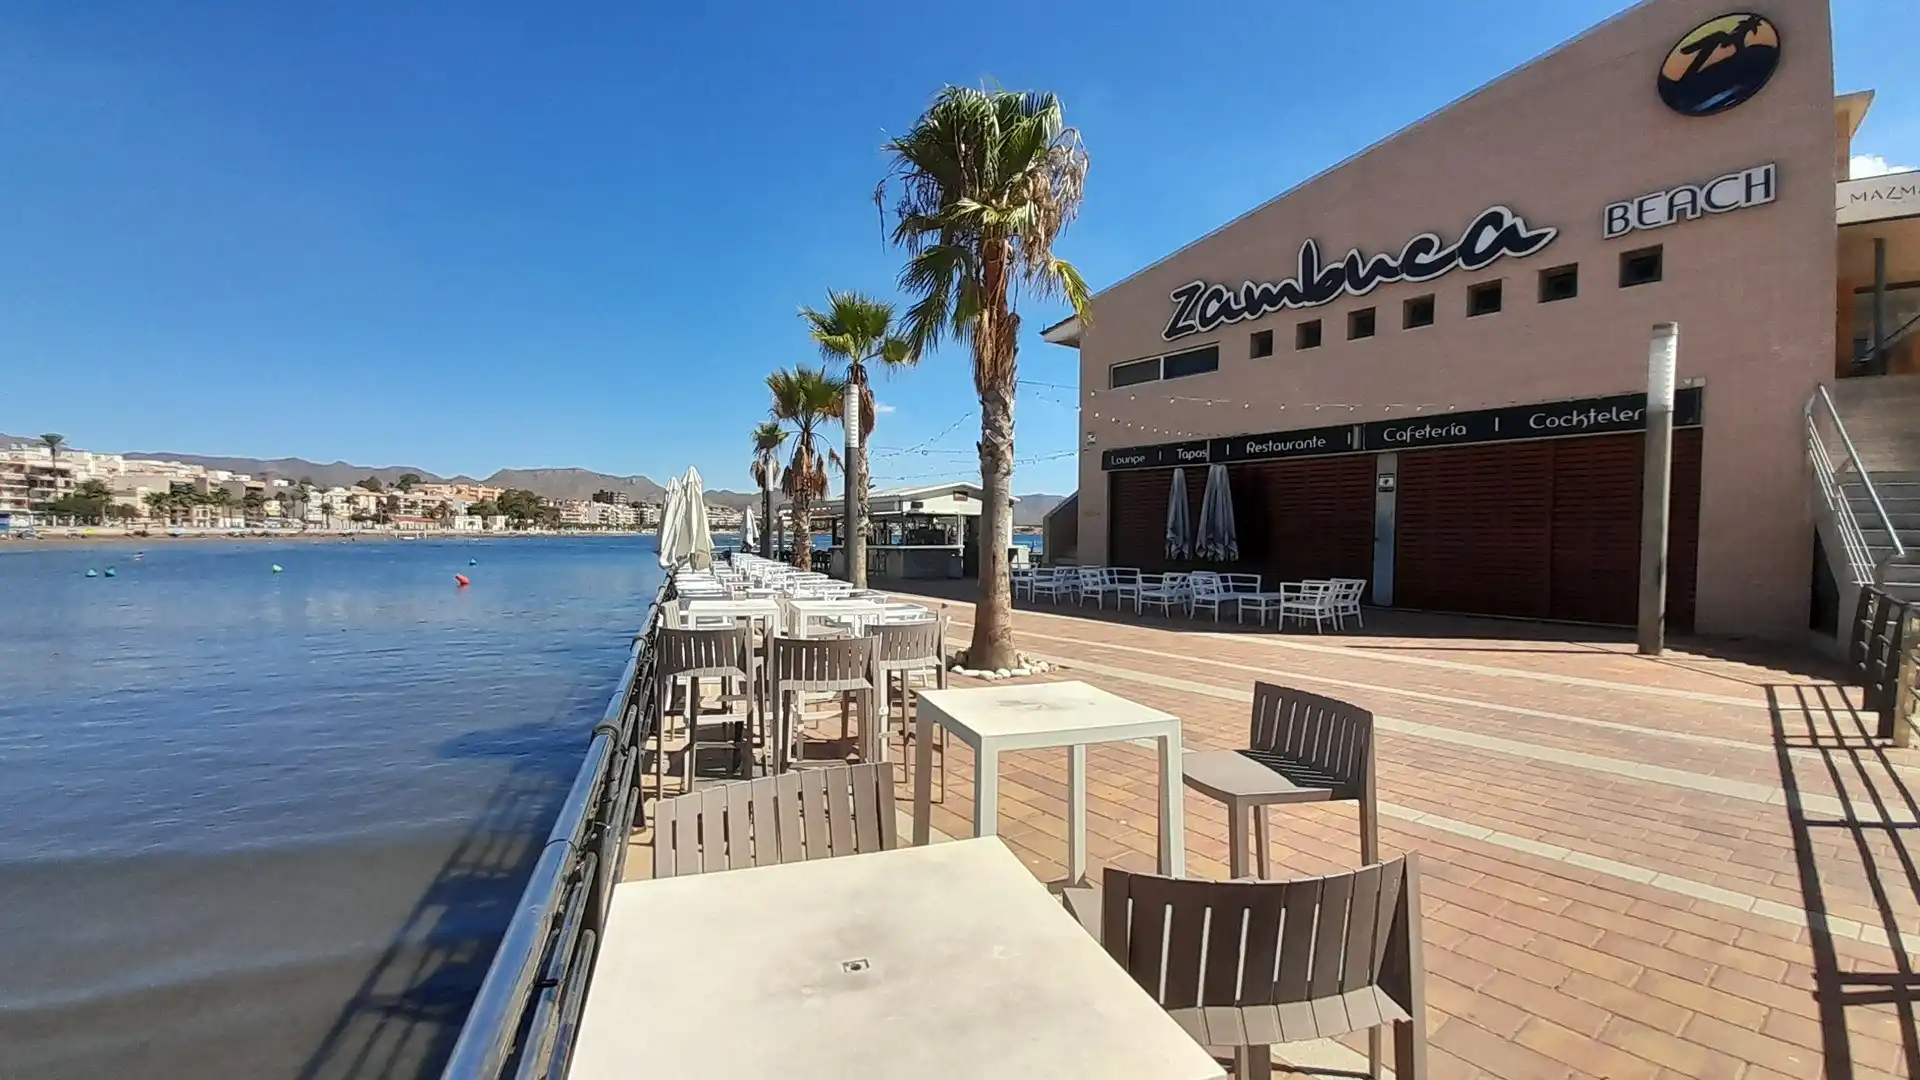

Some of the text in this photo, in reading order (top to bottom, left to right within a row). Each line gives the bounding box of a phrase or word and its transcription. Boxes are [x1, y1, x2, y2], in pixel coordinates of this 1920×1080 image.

[1162, 164, 1775, 341] Zambuca BEACH
[1176, 447, 1208, 461] Tapas
[1246, 436, 1327, 454] Restaurante
[1383, 421, 1467, 443] Cafetería
[1529, 405, 1645, 430] Cockteler
